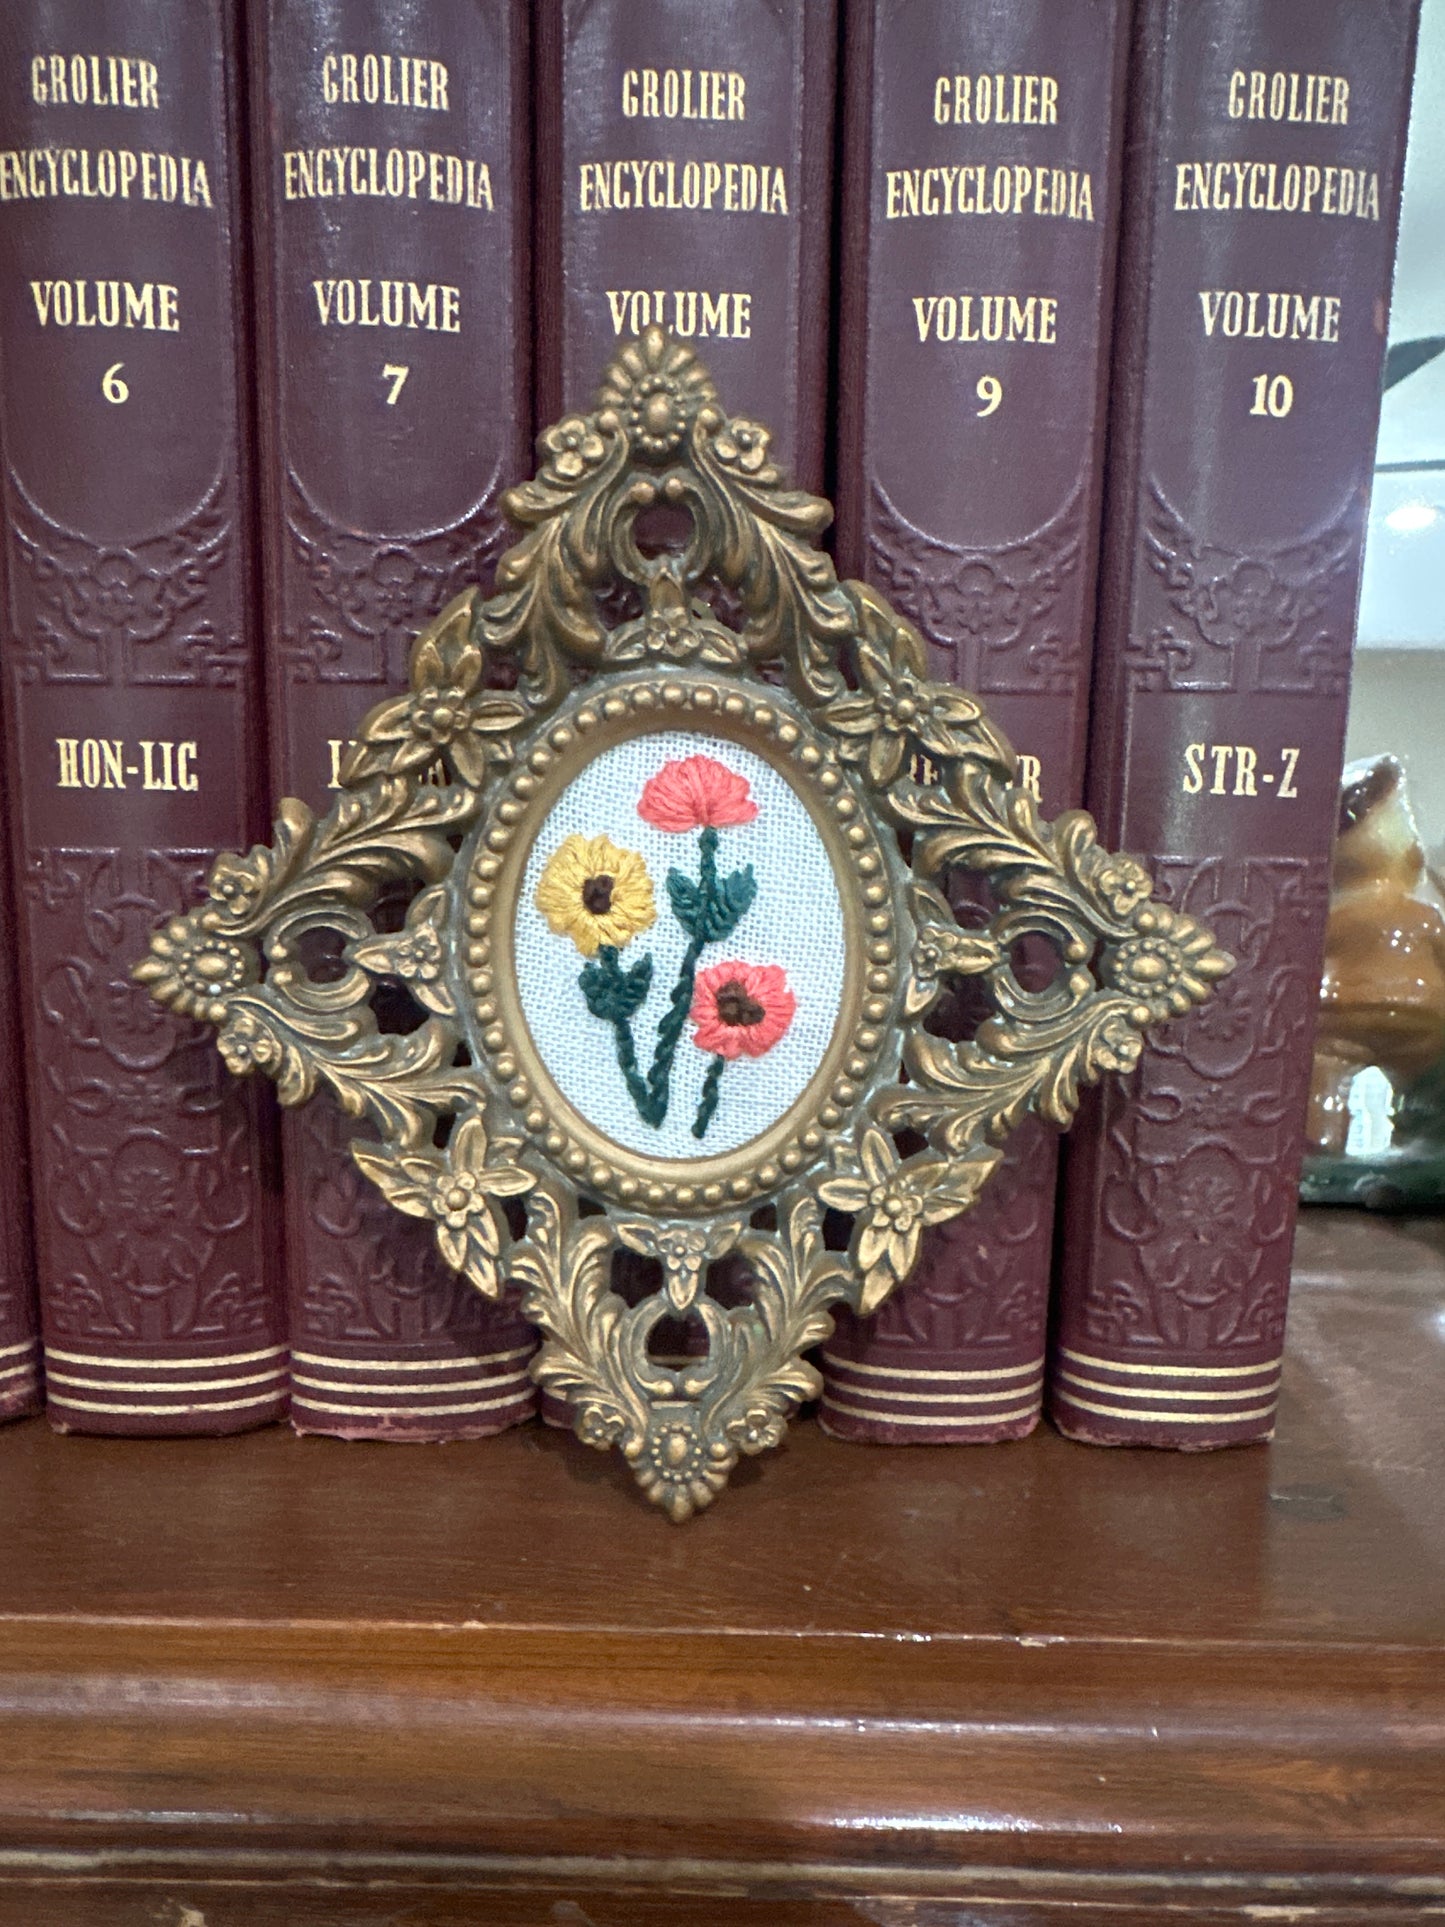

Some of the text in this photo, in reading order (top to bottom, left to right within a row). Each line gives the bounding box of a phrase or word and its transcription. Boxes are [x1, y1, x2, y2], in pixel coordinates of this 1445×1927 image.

[31, 54, 159, 109] GROLIER
[321, 54, 449, 111] GROLIER
[622, 69, 746, 121] GROLIER
[934, 74, 1058, 126] GROLIER
[1227, 70, 1350, 126] GROLIER
[0, 148, 213, 208] ENCYCLOPEDIA
[283, 147, 494, 211] ENCYCLOPEDIA
[579, 160, 788, 215] ENCYCLOPEDIA
[886, 165, 1094, 221] ENCYCLOPEDIA
[1174, 161, 1380, 221] ENCYCLOPEDIA
[30, 280, 180, 332] VOLUME
[312, 279, 461, 333] VOLUME
[912, 296, 1058, 344] VOLUME
[1198, 291, 1341, 343] VOLUME
[102, 363, 129, 404] 6
[382, 363, 409, 405] 7
[976, 375, 1003, 418] 9
[1249, 374, 1294, 418] 10
[56, 737, 199, 792] HON-LIC
[1182, 742, 1300, 798] STR-Z
